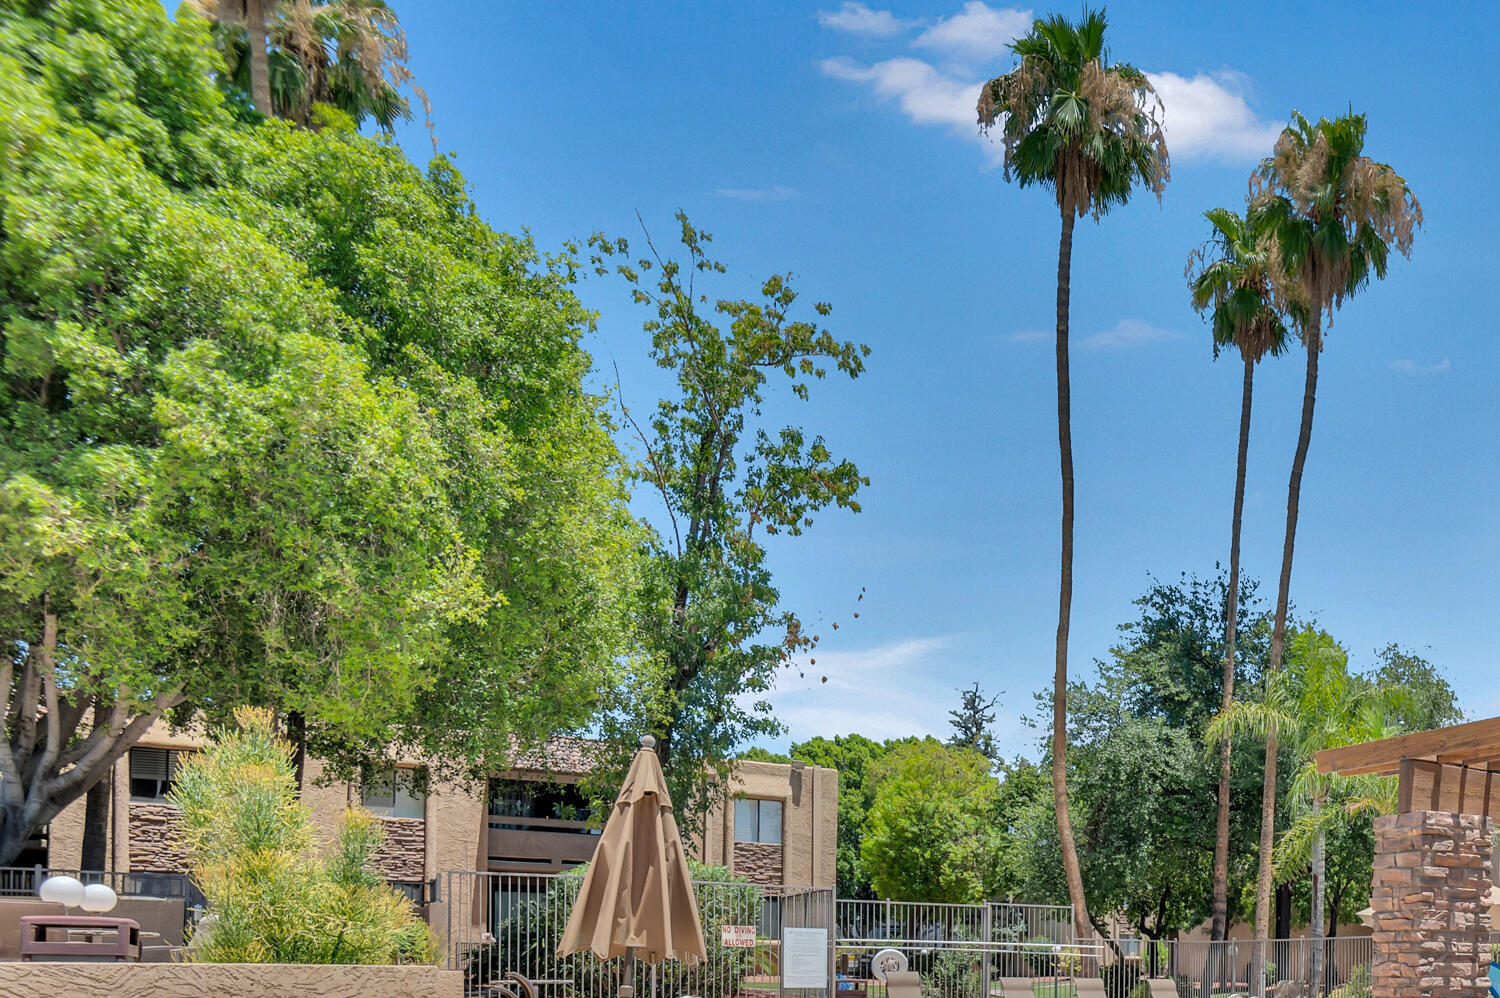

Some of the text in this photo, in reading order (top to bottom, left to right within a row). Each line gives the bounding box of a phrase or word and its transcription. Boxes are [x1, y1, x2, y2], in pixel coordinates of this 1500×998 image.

[722, 926, 756, 934] NO DIVING
[724, 938, 754, 947] ALLOWED
